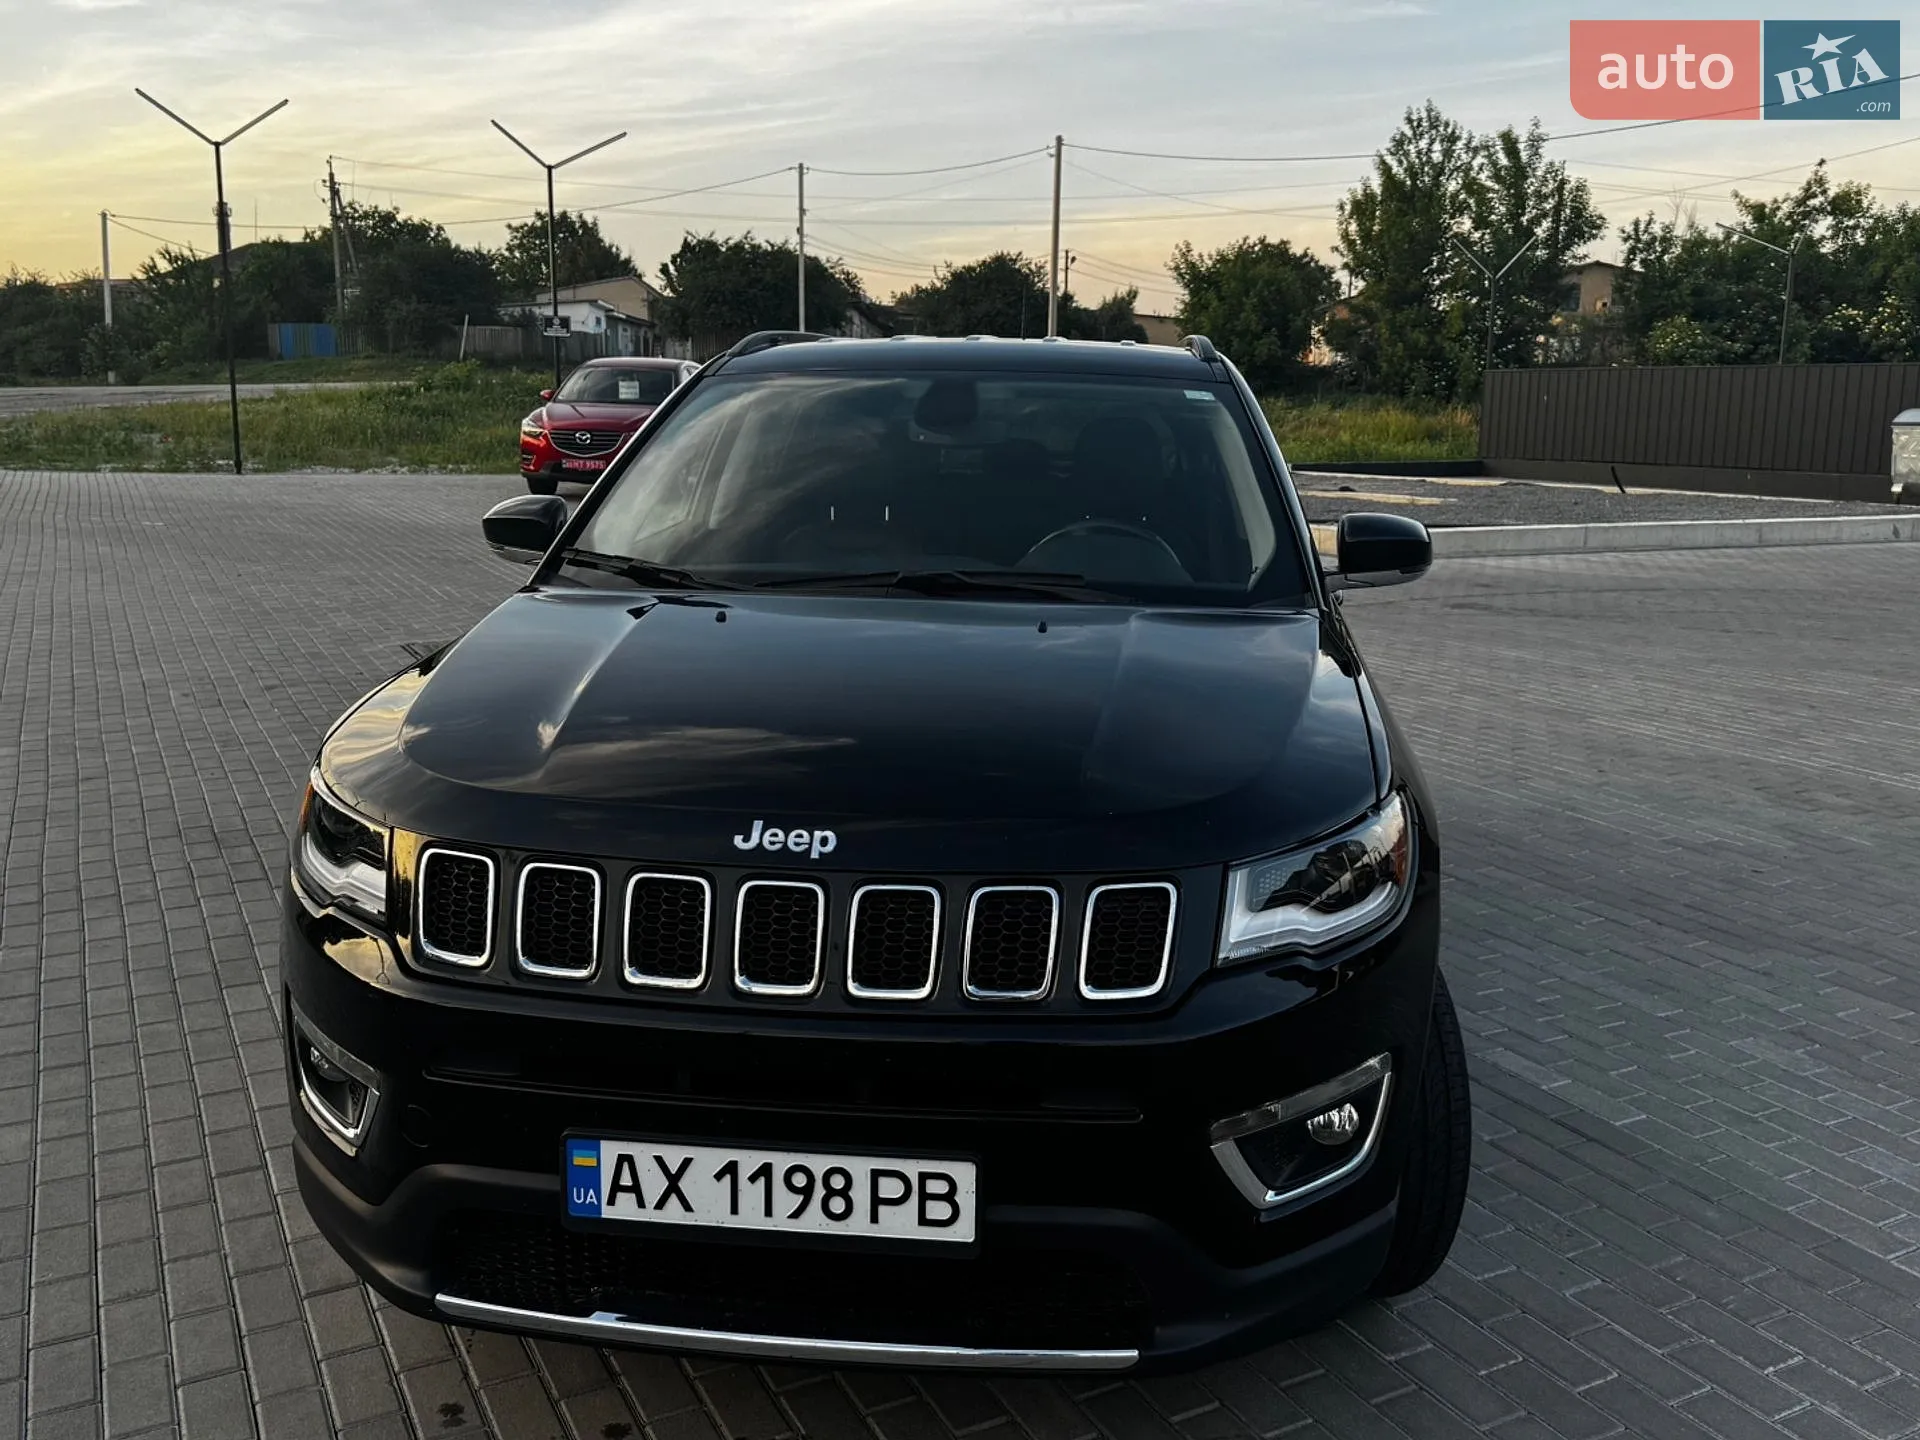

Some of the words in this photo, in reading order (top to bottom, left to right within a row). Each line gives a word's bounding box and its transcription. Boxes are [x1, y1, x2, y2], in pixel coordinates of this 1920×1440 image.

[733, 820, 837, 859] Jeep
[572, 1187, 598, 1206] UA
[606, 1153, 695, 1213] AX
[712, 1159, 854, 1222] 1198
[869, 1167, 961, 1228] PB
